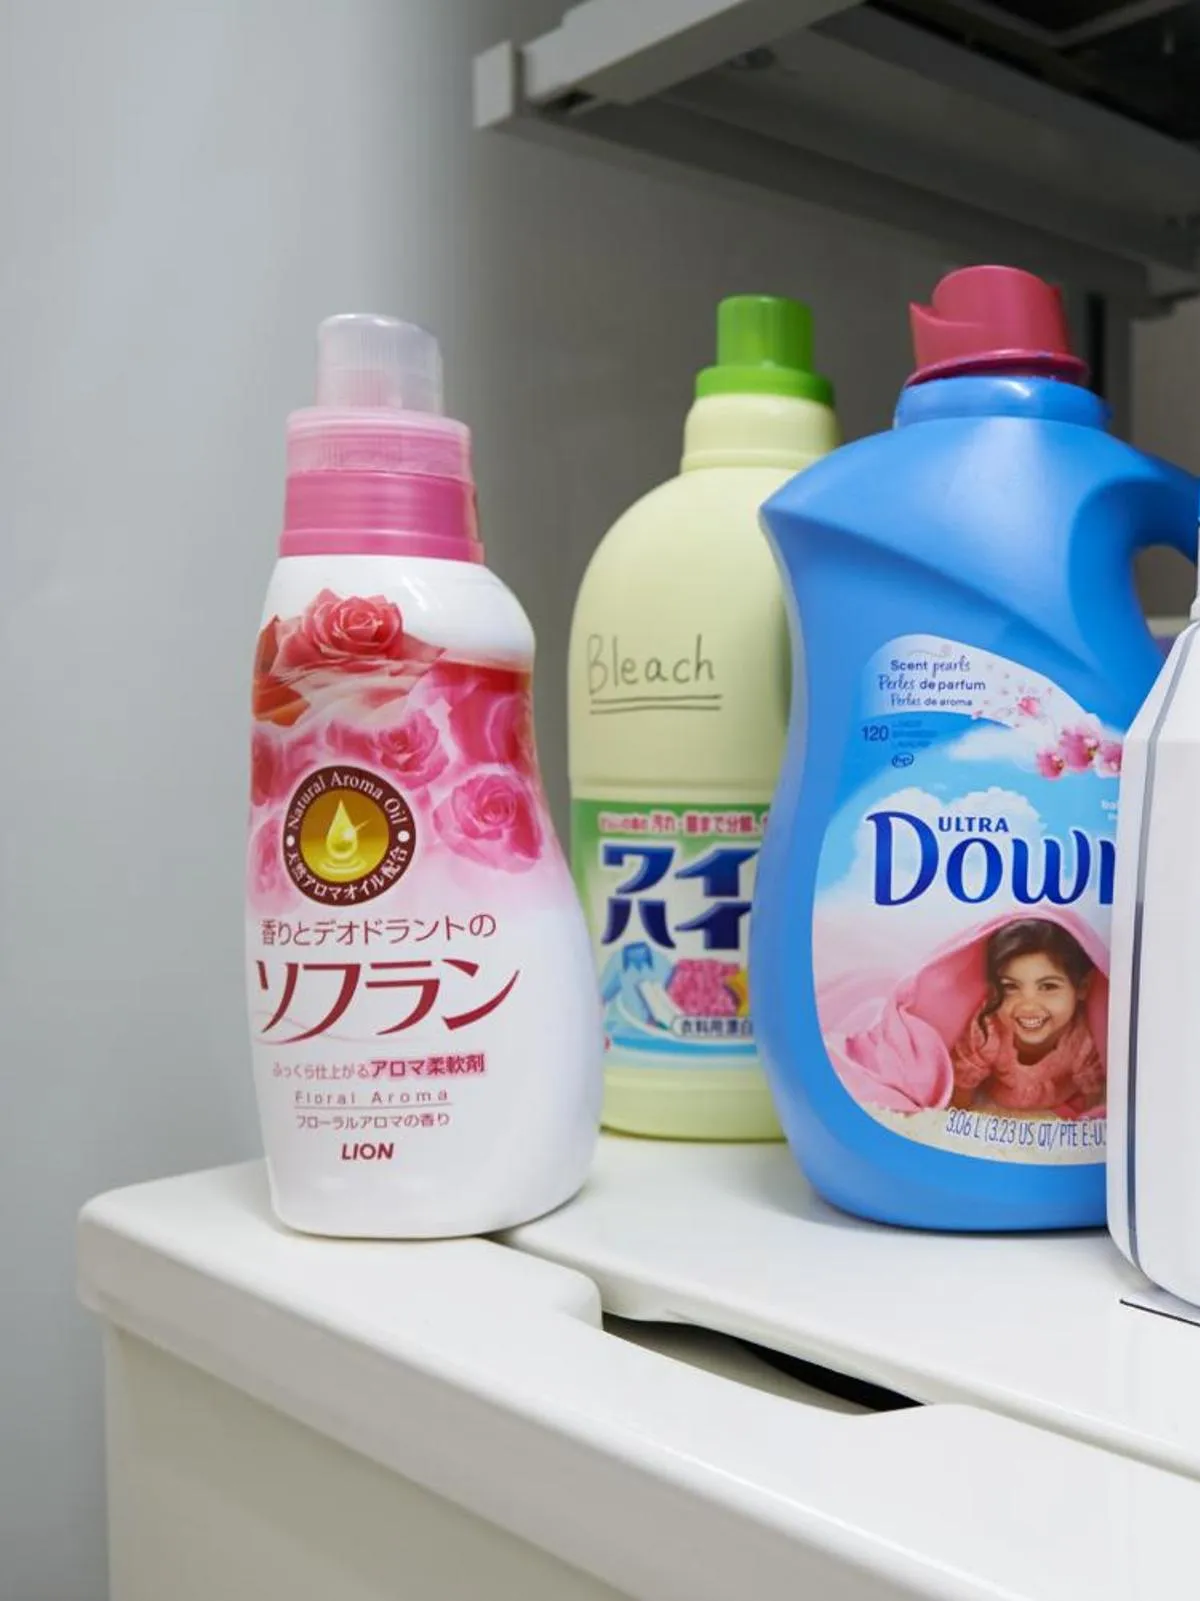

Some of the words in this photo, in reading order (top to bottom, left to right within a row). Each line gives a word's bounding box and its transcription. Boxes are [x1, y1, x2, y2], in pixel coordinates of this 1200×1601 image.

[587, 633, 715, 695] Bleach
[890, 659, 928, 671] Scent
[932, 655, 970, 678] pearls
[919, 679, 936, 690] de
[938, 680, 986, 692] parfum
[924, 697, 937, 706] de
[939, 697, 973, 706] aroma
[862, 724, 889, 742] 120
[287, 775, 326, 830] Natural
[330, 771, 384, 800] Aroma
[384, 798, 408, 825] Oil
[938, 817, 1009, 833] ULTRA
[261, 913, 497, 947] 香りとデオドラントの
[255, 958, 520, 1045] ソフラン
[295, 1090, 356, 1105] Floral
[371, 1089, 449, 1105] Aroma
[296, 1111, 450, 1130] フローラルアロマの香り
[946, 1108, 973, 1137] 3.06
[974, 1115, 980, 1138] L
[984, 1117, 1017, 1143] (3.23
[1019, 1123, 1035, 1146] US
[340, 1142, 395, 1161] LION
